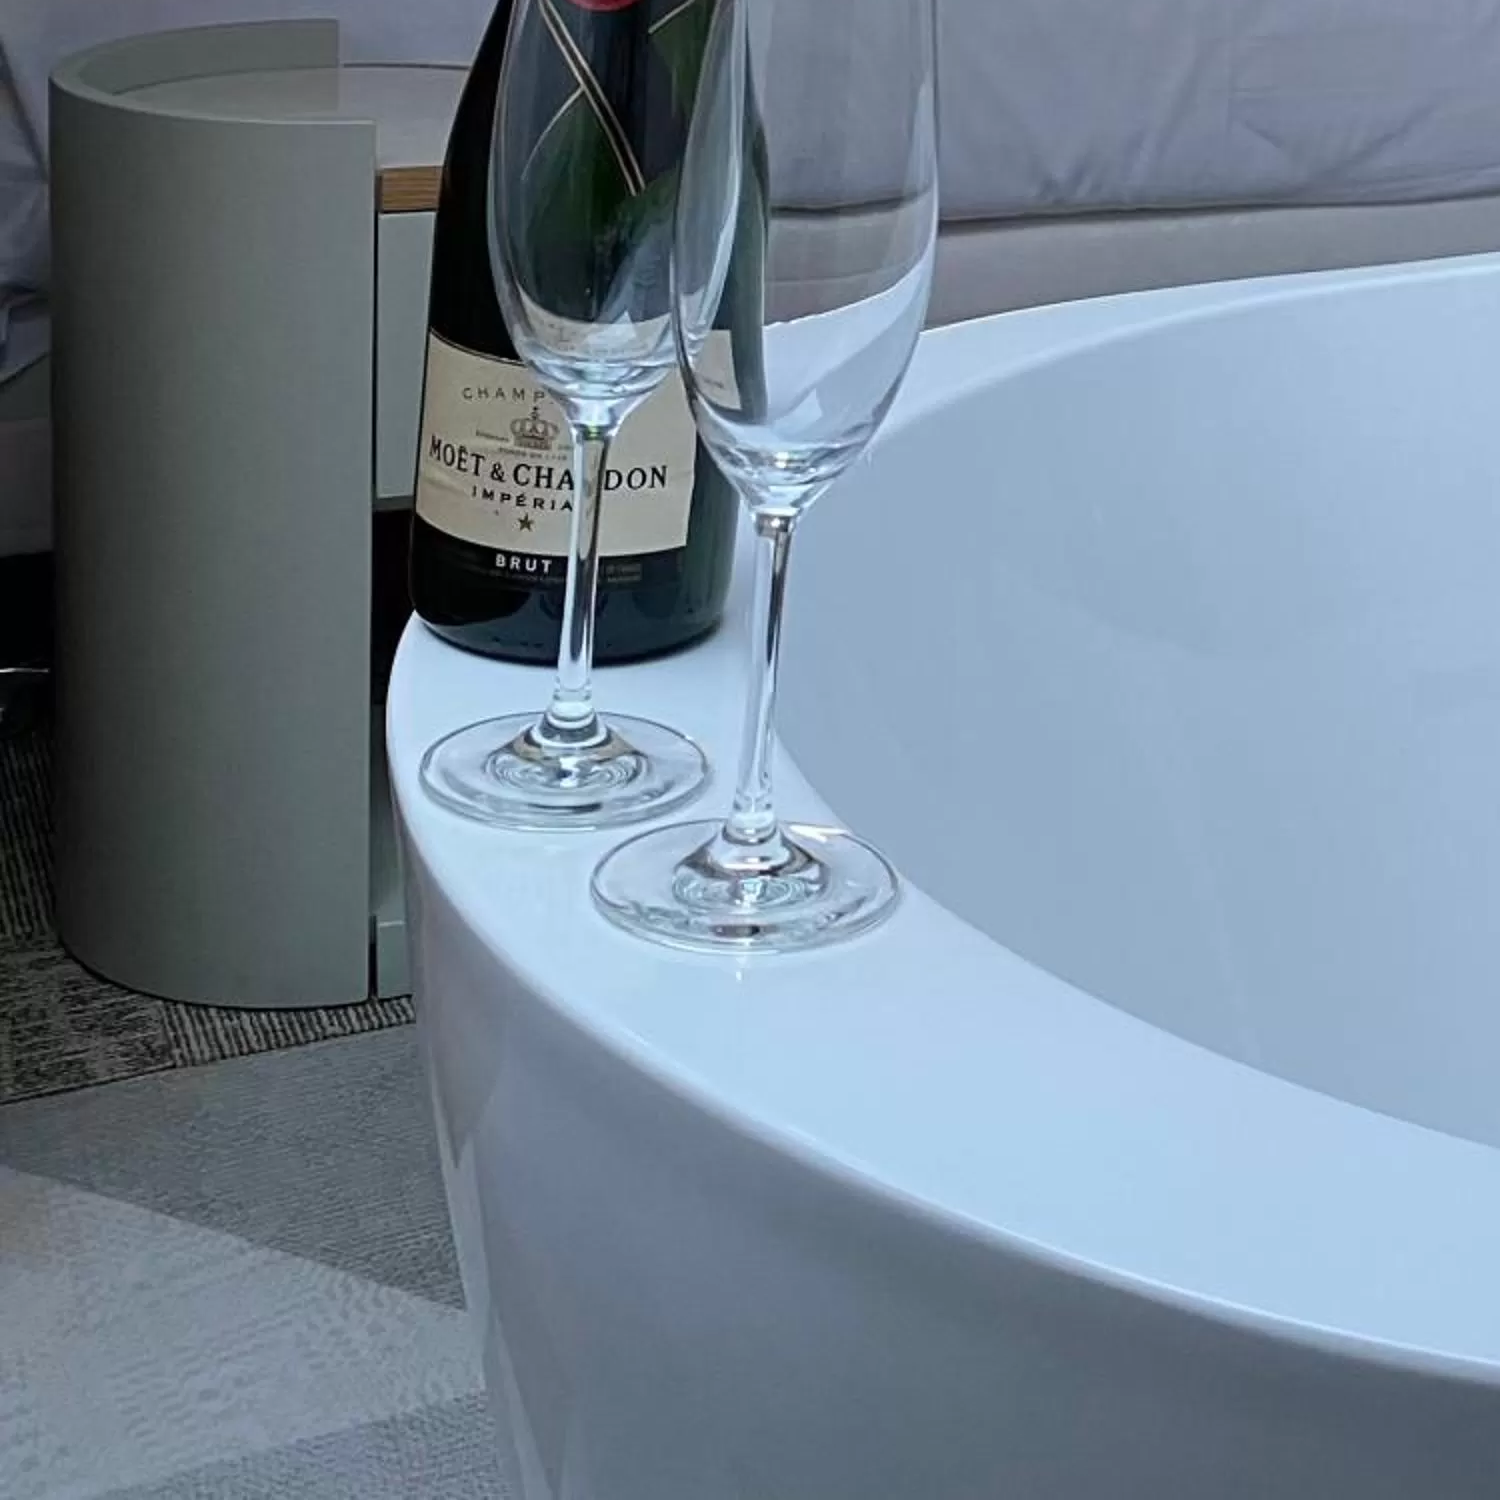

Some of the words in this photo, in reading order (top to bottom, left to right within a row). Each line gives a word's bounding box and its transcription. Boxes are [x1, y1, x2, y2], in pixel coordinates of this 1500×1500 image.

[461, 386, 555, 405] CHAMP
[491, 462, 506, 484] &
[513, 463, 668, 492] CHADON
[472, 486, 574, 512] IMPÉRIA
[495, 553, 552, 573] BRUT
